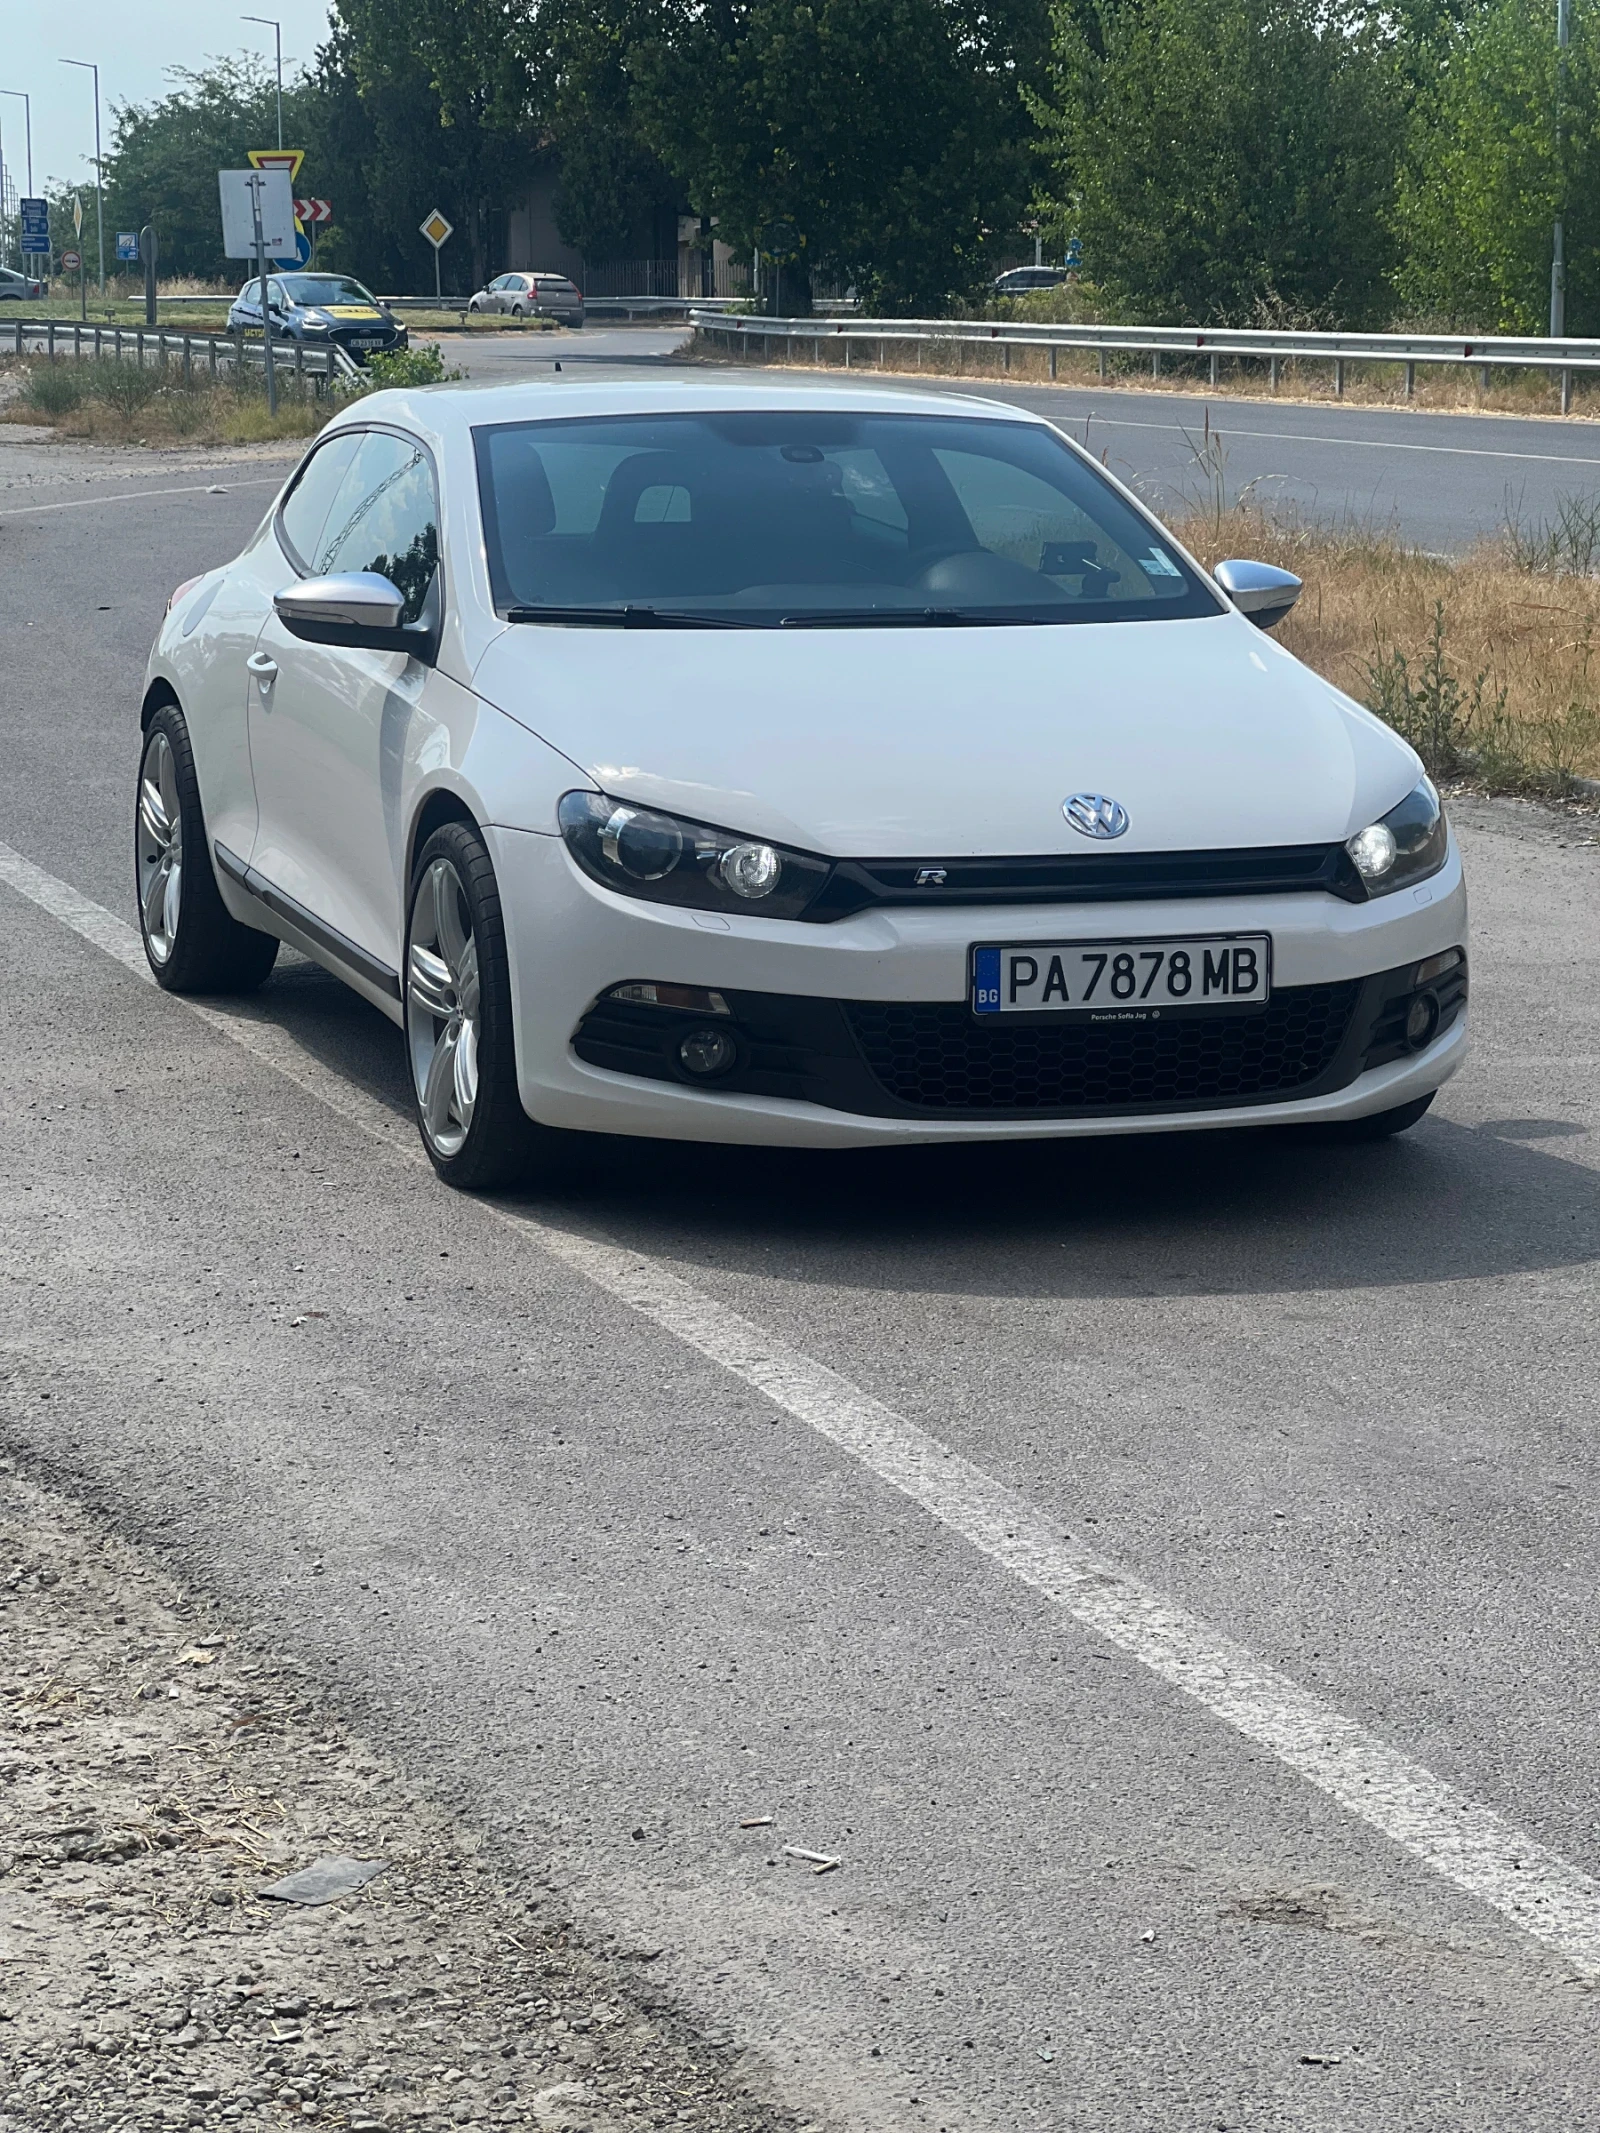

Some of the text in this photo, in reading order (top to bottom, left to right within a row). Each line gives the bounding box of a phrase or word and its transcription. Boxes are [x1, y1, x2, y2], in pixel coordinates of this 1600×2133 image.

[914, 867, 947, 884] R
[1009, 947, 1259, 1003] PA 7878 MB
[978, 989, 998, 1004] BG
[1117, 1012, 1134, 1020] Sofia
